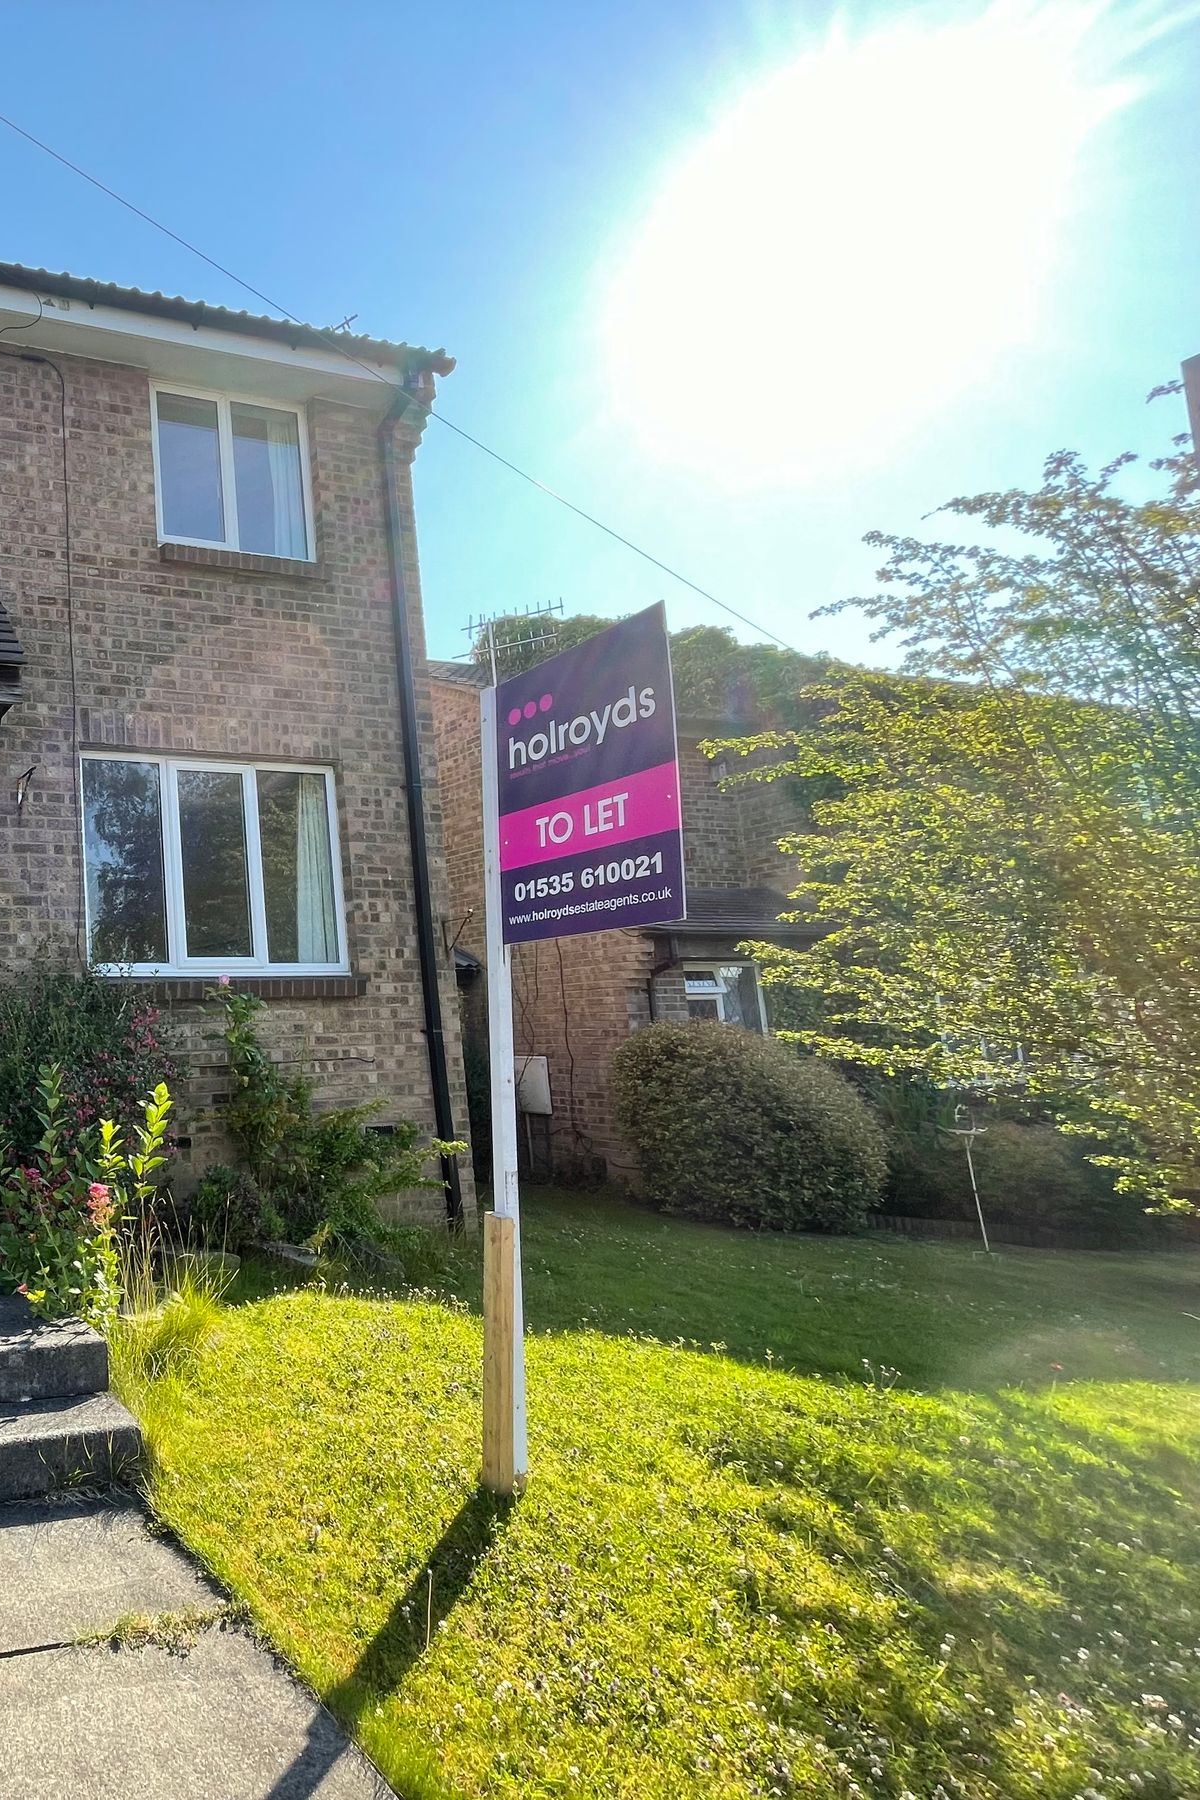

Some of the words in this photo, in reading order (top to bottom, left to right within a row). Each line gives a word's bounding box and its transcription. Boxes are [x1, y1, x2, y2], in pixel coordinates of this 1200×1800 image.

[508, 685, 656, 769] holroyds
[535, 811, 574, 848] TO
[583, 792, 629, 836] LET
[514, 872, 574, 902] 01535
[580, 851, 663, 889] 610021
[508, 886, 672, 925] www.holroydsestateagents.co.uk
